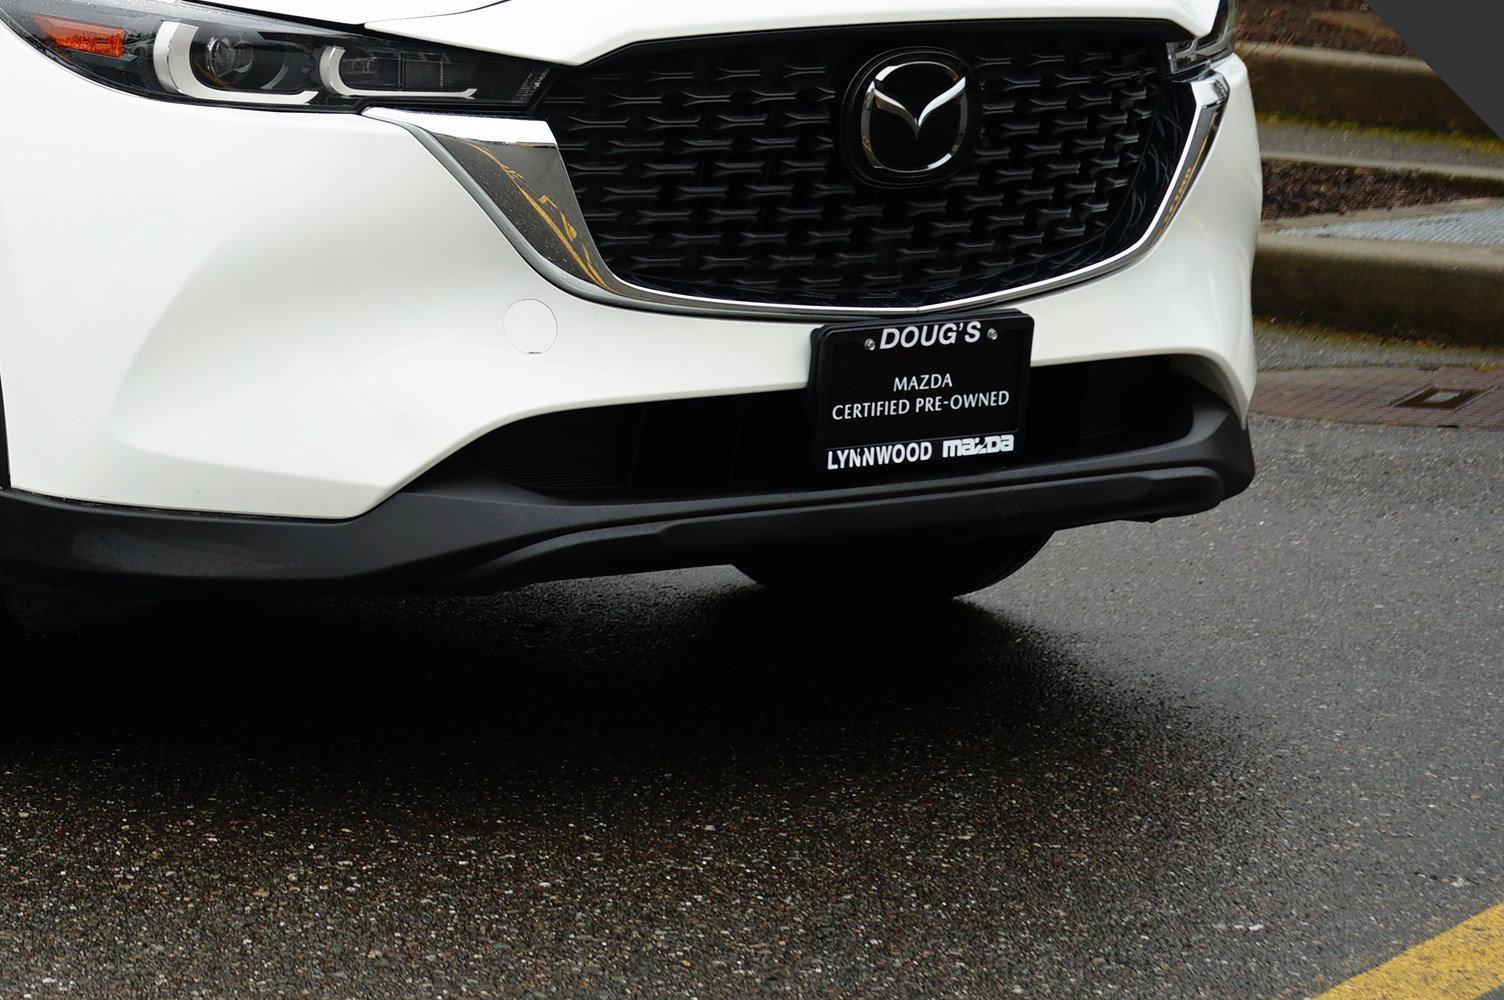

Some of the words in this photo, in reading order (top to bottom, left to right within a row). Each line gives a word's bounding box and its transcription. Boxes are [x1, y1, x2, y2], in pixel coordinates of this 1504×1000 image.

[879, 320, 983, 350] DOUG'S
[893, 372, 953, 392] MAZDA
[831, 399, 911, 421] CERTIFIED
[915, 390, 1010, 413] PRE-OWNED
[827, 441, 933, 470] LYNNWOOD
[941, 434, 1015, 458] mazda
